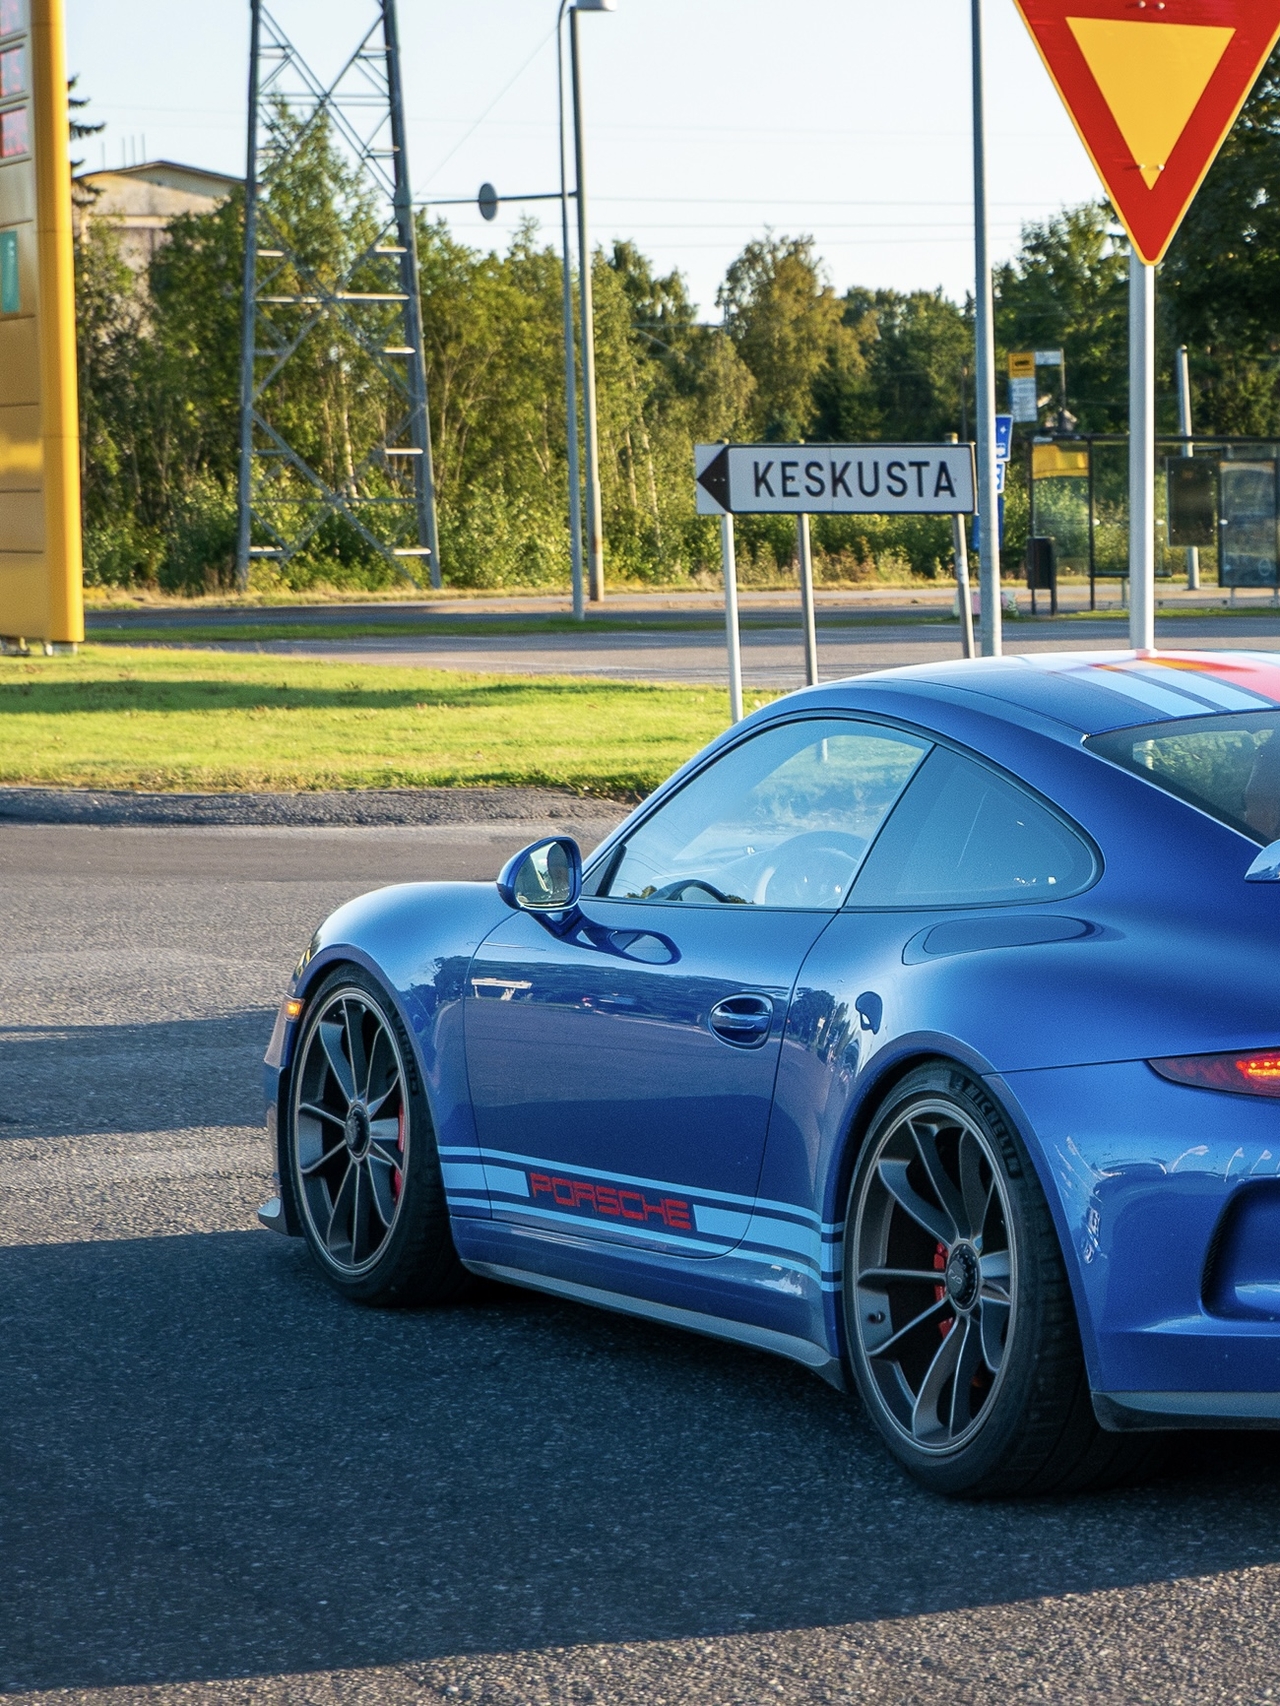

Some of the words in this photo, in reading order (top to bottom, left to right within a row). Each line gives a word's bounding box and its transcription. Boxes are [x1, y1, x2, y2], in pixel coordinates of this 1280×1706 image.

[753, 460, 957, 498] KESKUSTA
[963, 1080, 1020, 1174] MICHELIN
[530, 1172, 692, 1230] PORSCHE
